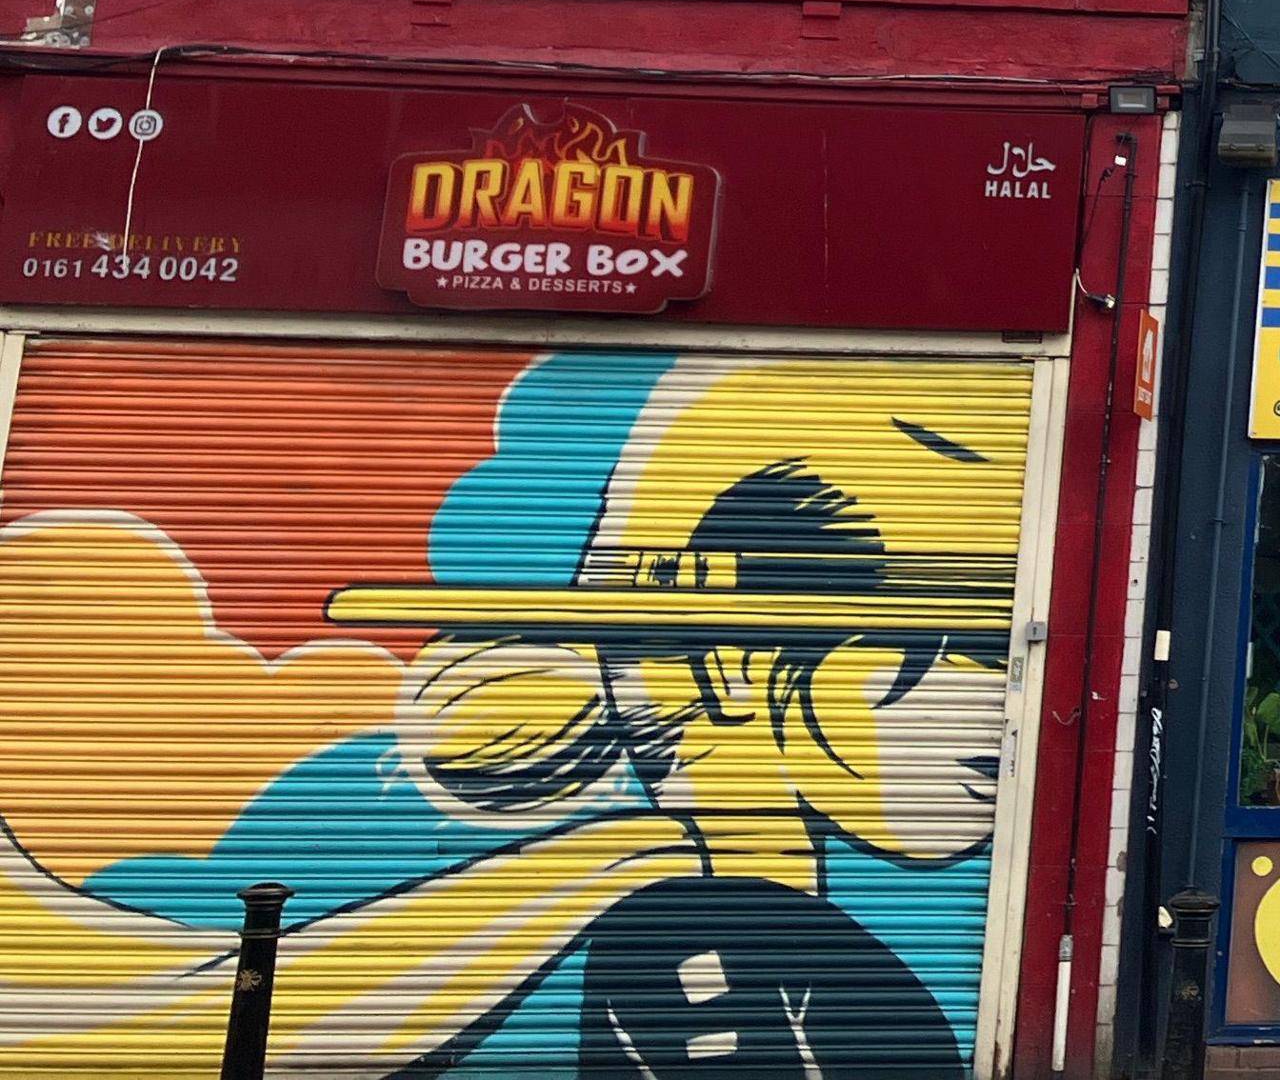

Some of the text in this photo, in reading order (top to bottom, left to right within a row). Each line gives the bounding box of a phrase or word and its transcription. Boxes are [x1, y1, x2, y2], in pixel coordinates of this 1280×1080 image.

[986, 141, 1056, 178] حلال
[405, 159, 694, 244] DRAGON
[984, 180, 1051, 199] HALAL
[28, 231, 98, 250] FREE
[22, 254, 239, 282] 0161 434 0042
[402, 238, 688, 278] BURGER BOX
[452, 276, 623, 294] PIZZA & DESSERTS
